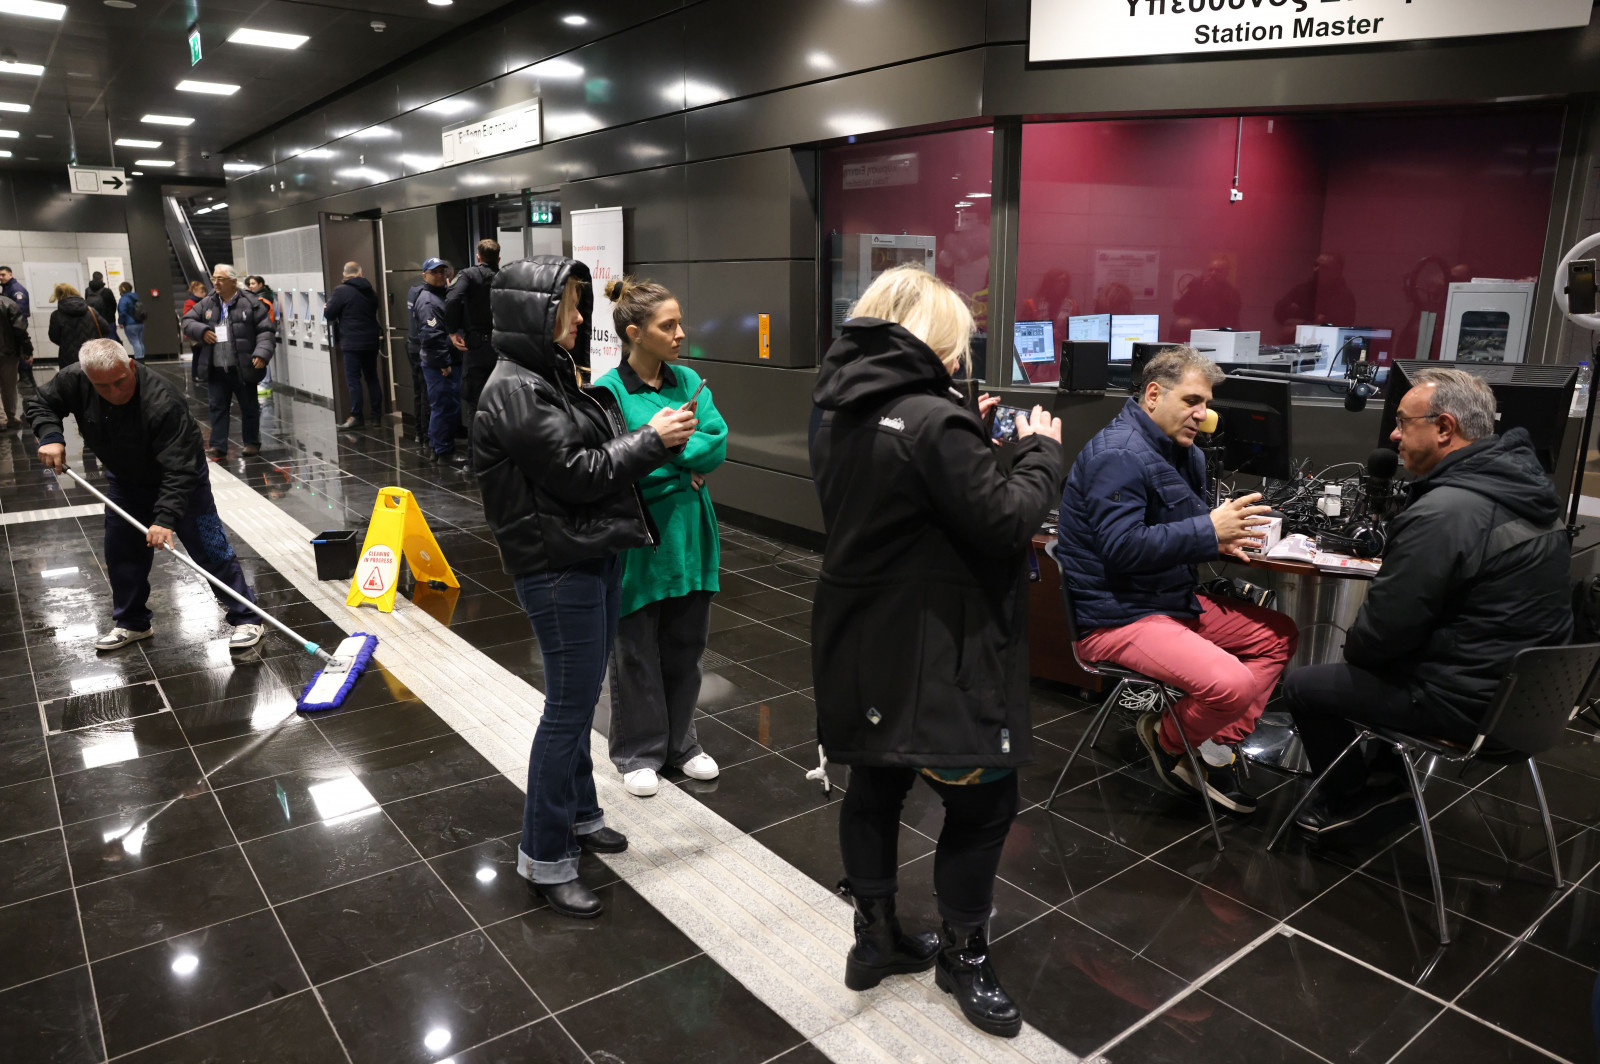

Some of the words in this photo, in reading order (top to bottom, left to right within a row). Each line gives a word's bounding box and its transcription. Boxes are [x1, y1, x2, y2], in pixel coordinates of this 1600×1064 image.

[1194, 21, 1283, 45] Station
[1293, 15, 1385, 39] Master
[592, 259, 611, 280] dna
[590, 326, 609, 342] tus
[603, 346, 618, 357] 107.7
